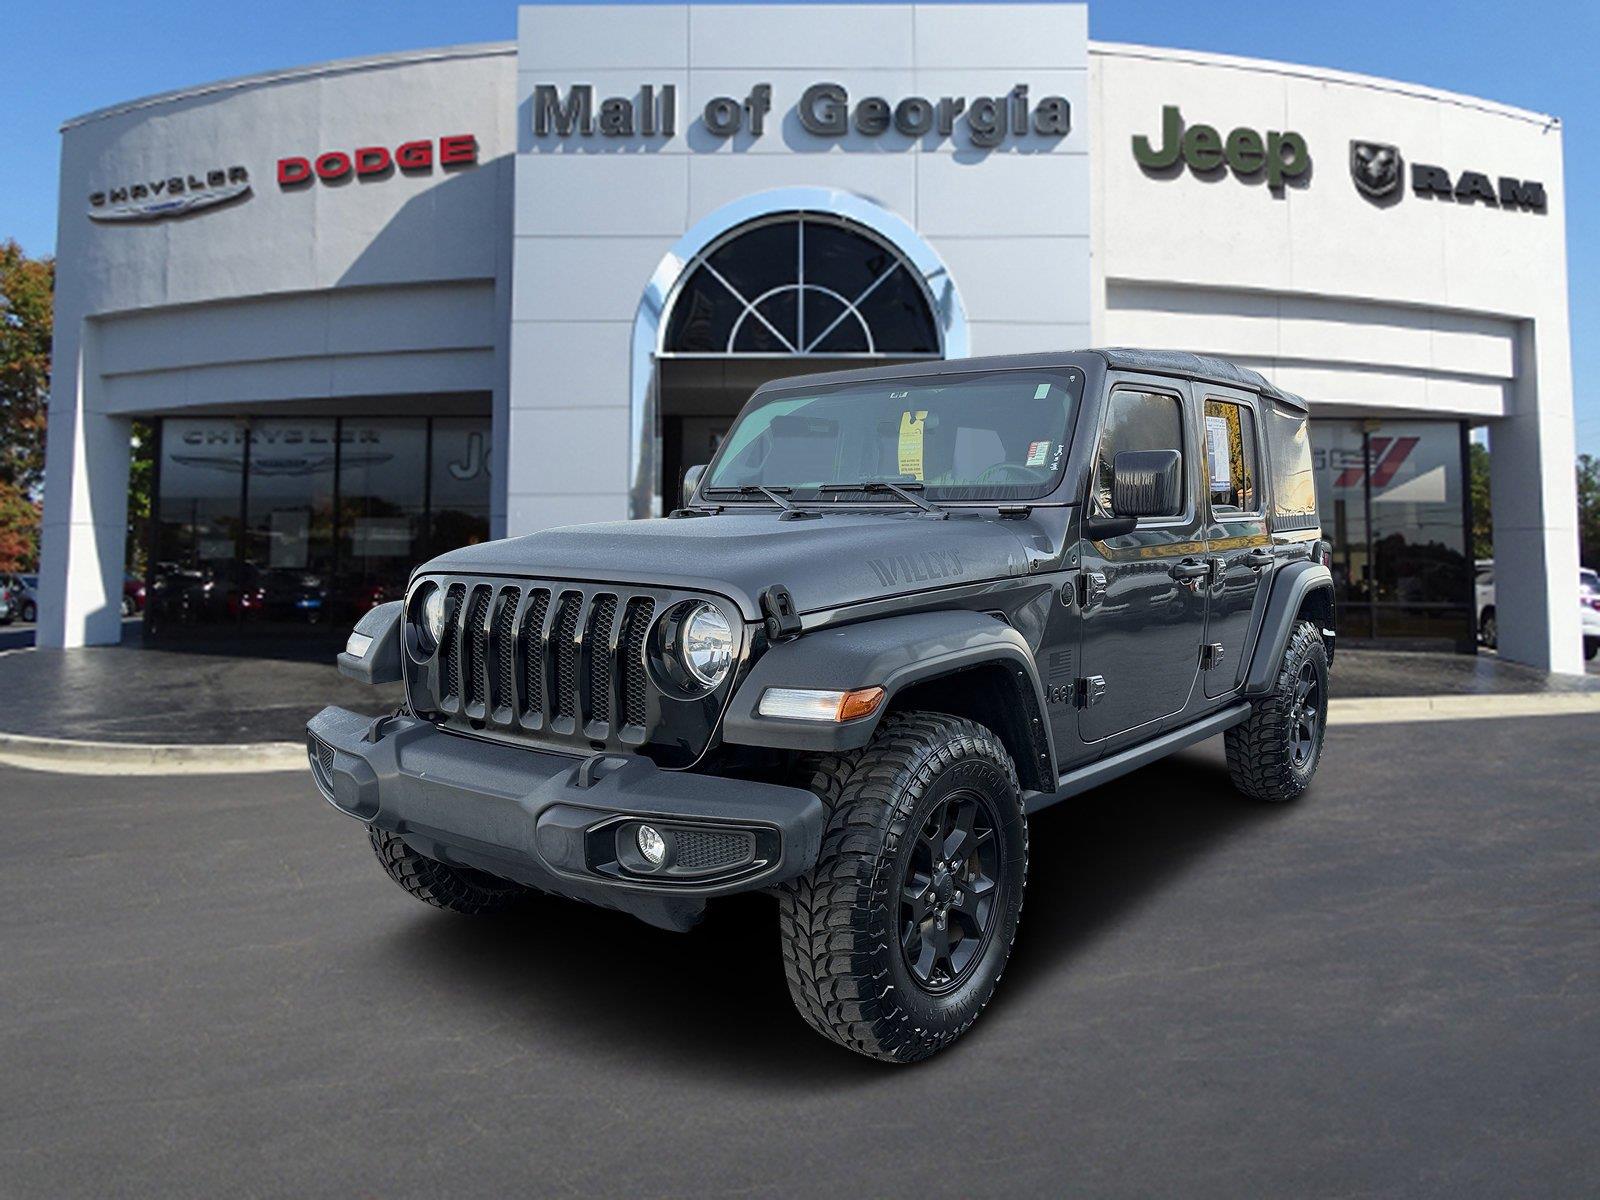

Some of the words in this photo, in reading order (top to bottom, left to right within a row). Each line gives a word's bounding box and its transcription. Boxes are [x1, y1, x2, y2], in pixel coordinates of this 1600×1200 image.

[533, 84, 677, 139] Mall
[703, 84, 773, 139] of
[800, 83, 1073, 149] Georgia
[277, 134, 478, 186] DODGE
[1131, 105, 1309, 191] Jeep
[89, 166, 249, 207] CHRYSLER
[1411, 163, 1545, 212] RAM
[865, 549, 964, 587] WILLYS
